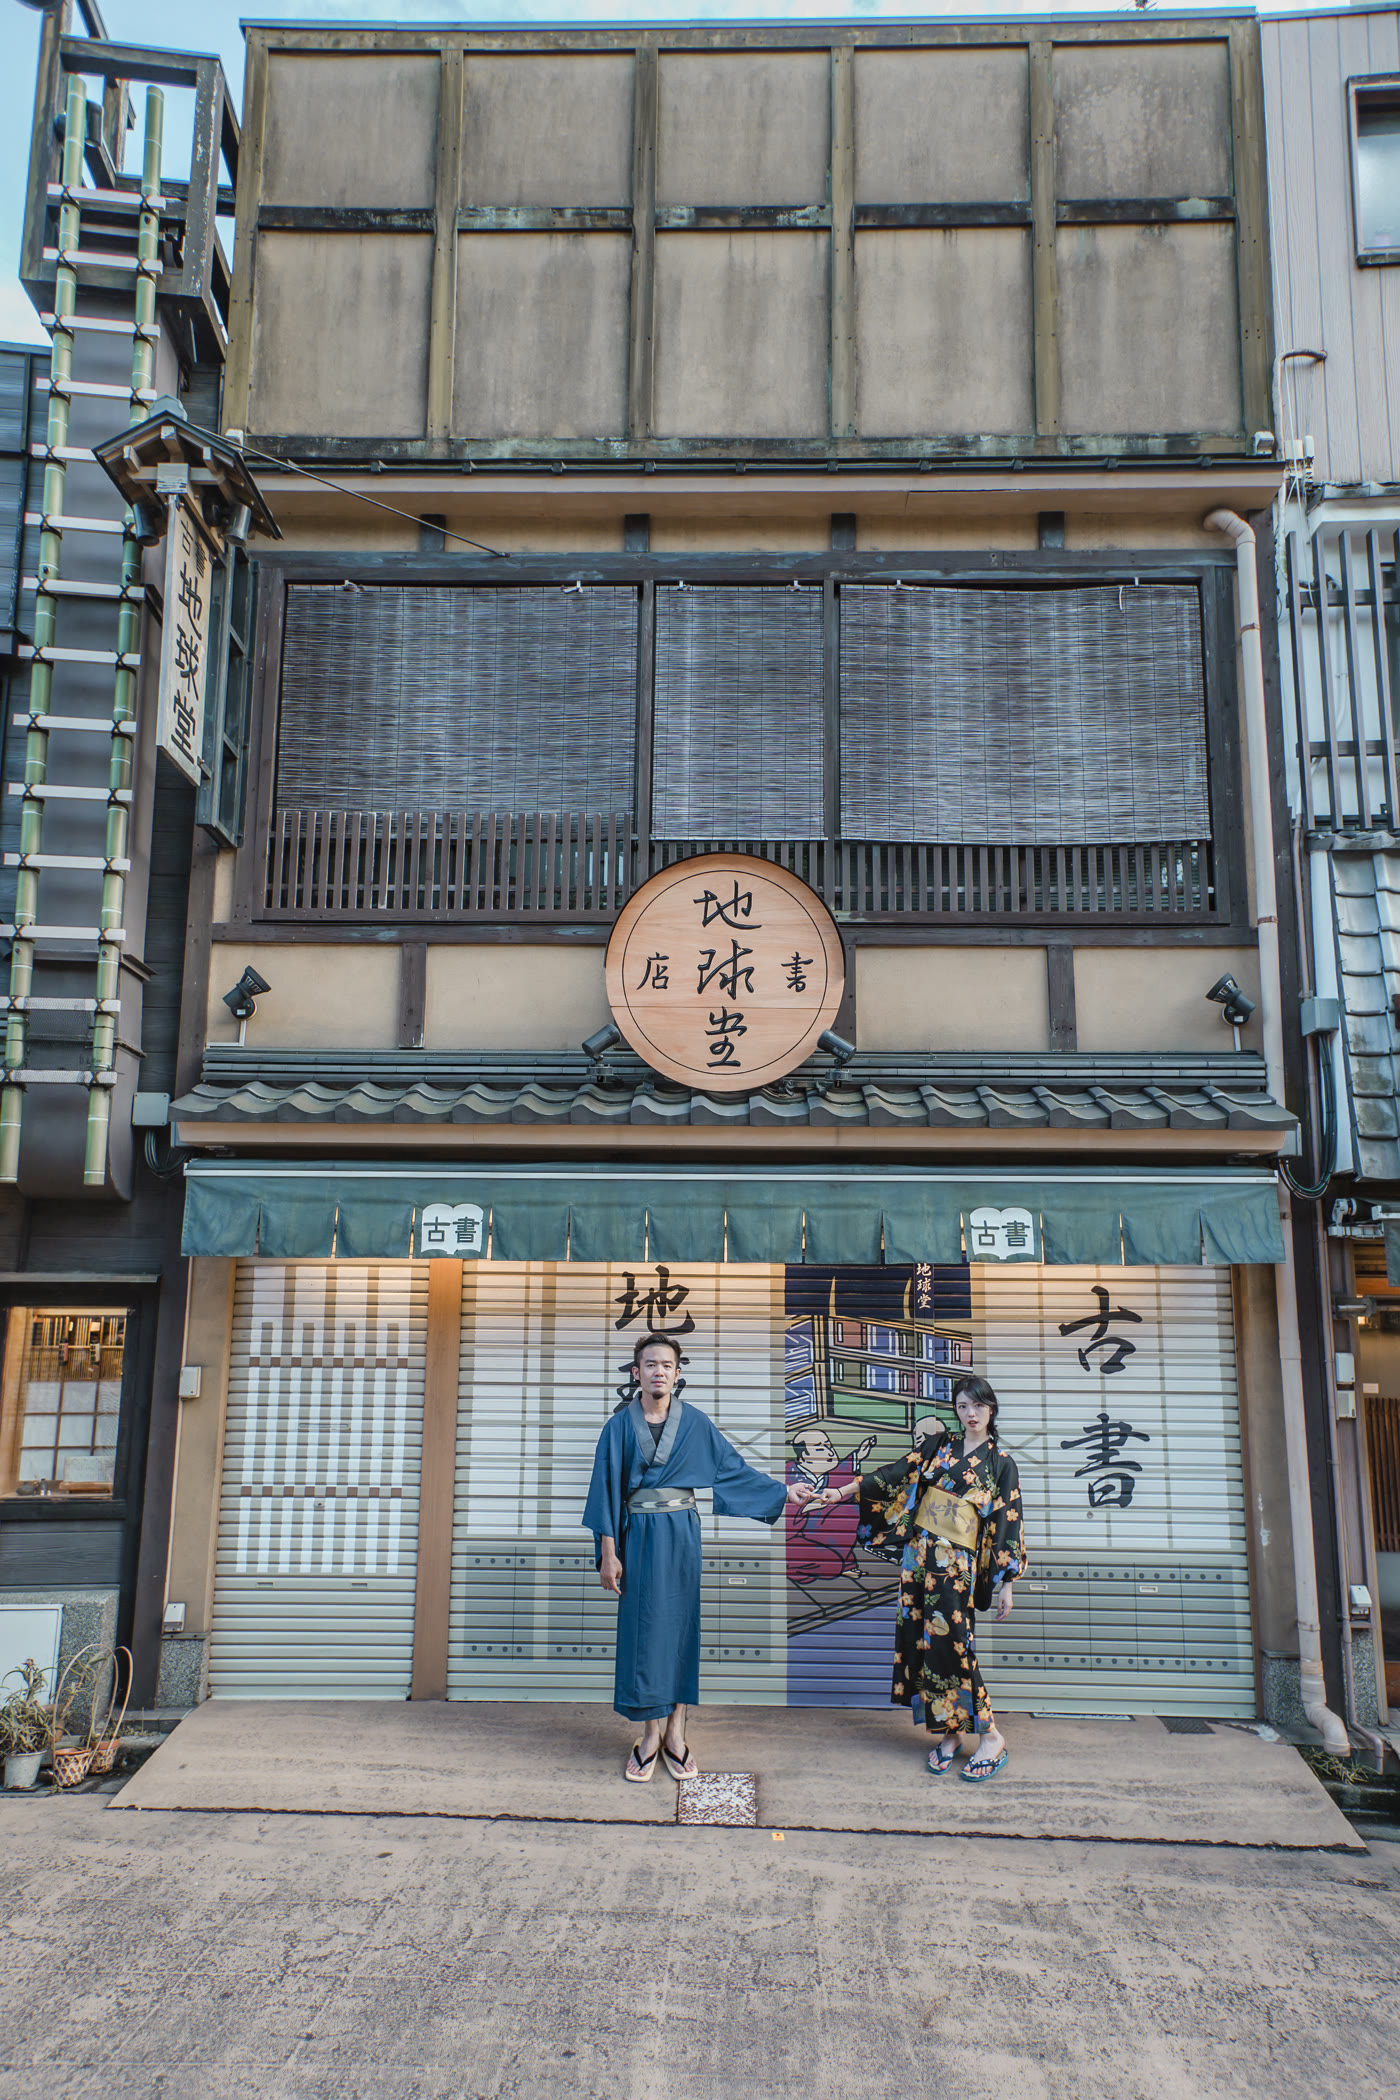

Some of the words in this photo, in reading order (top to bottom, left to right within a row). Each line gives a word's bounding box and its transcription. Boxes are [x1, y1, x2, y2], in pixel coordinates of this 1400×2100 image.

[171, 561, 202, 765] 地球堂
[636, 951, 670, 991] 店
[693, 880, 762, 1067] 地球堂
[781, 951, 814, 993] 書
[423, 1216, 480, 1243] 古書
[971, 1220, 1030, 1247] 古書
[916, 1262, 932, 1309] 地球堂
[1058, 1285, 1150, 1508] 古書
